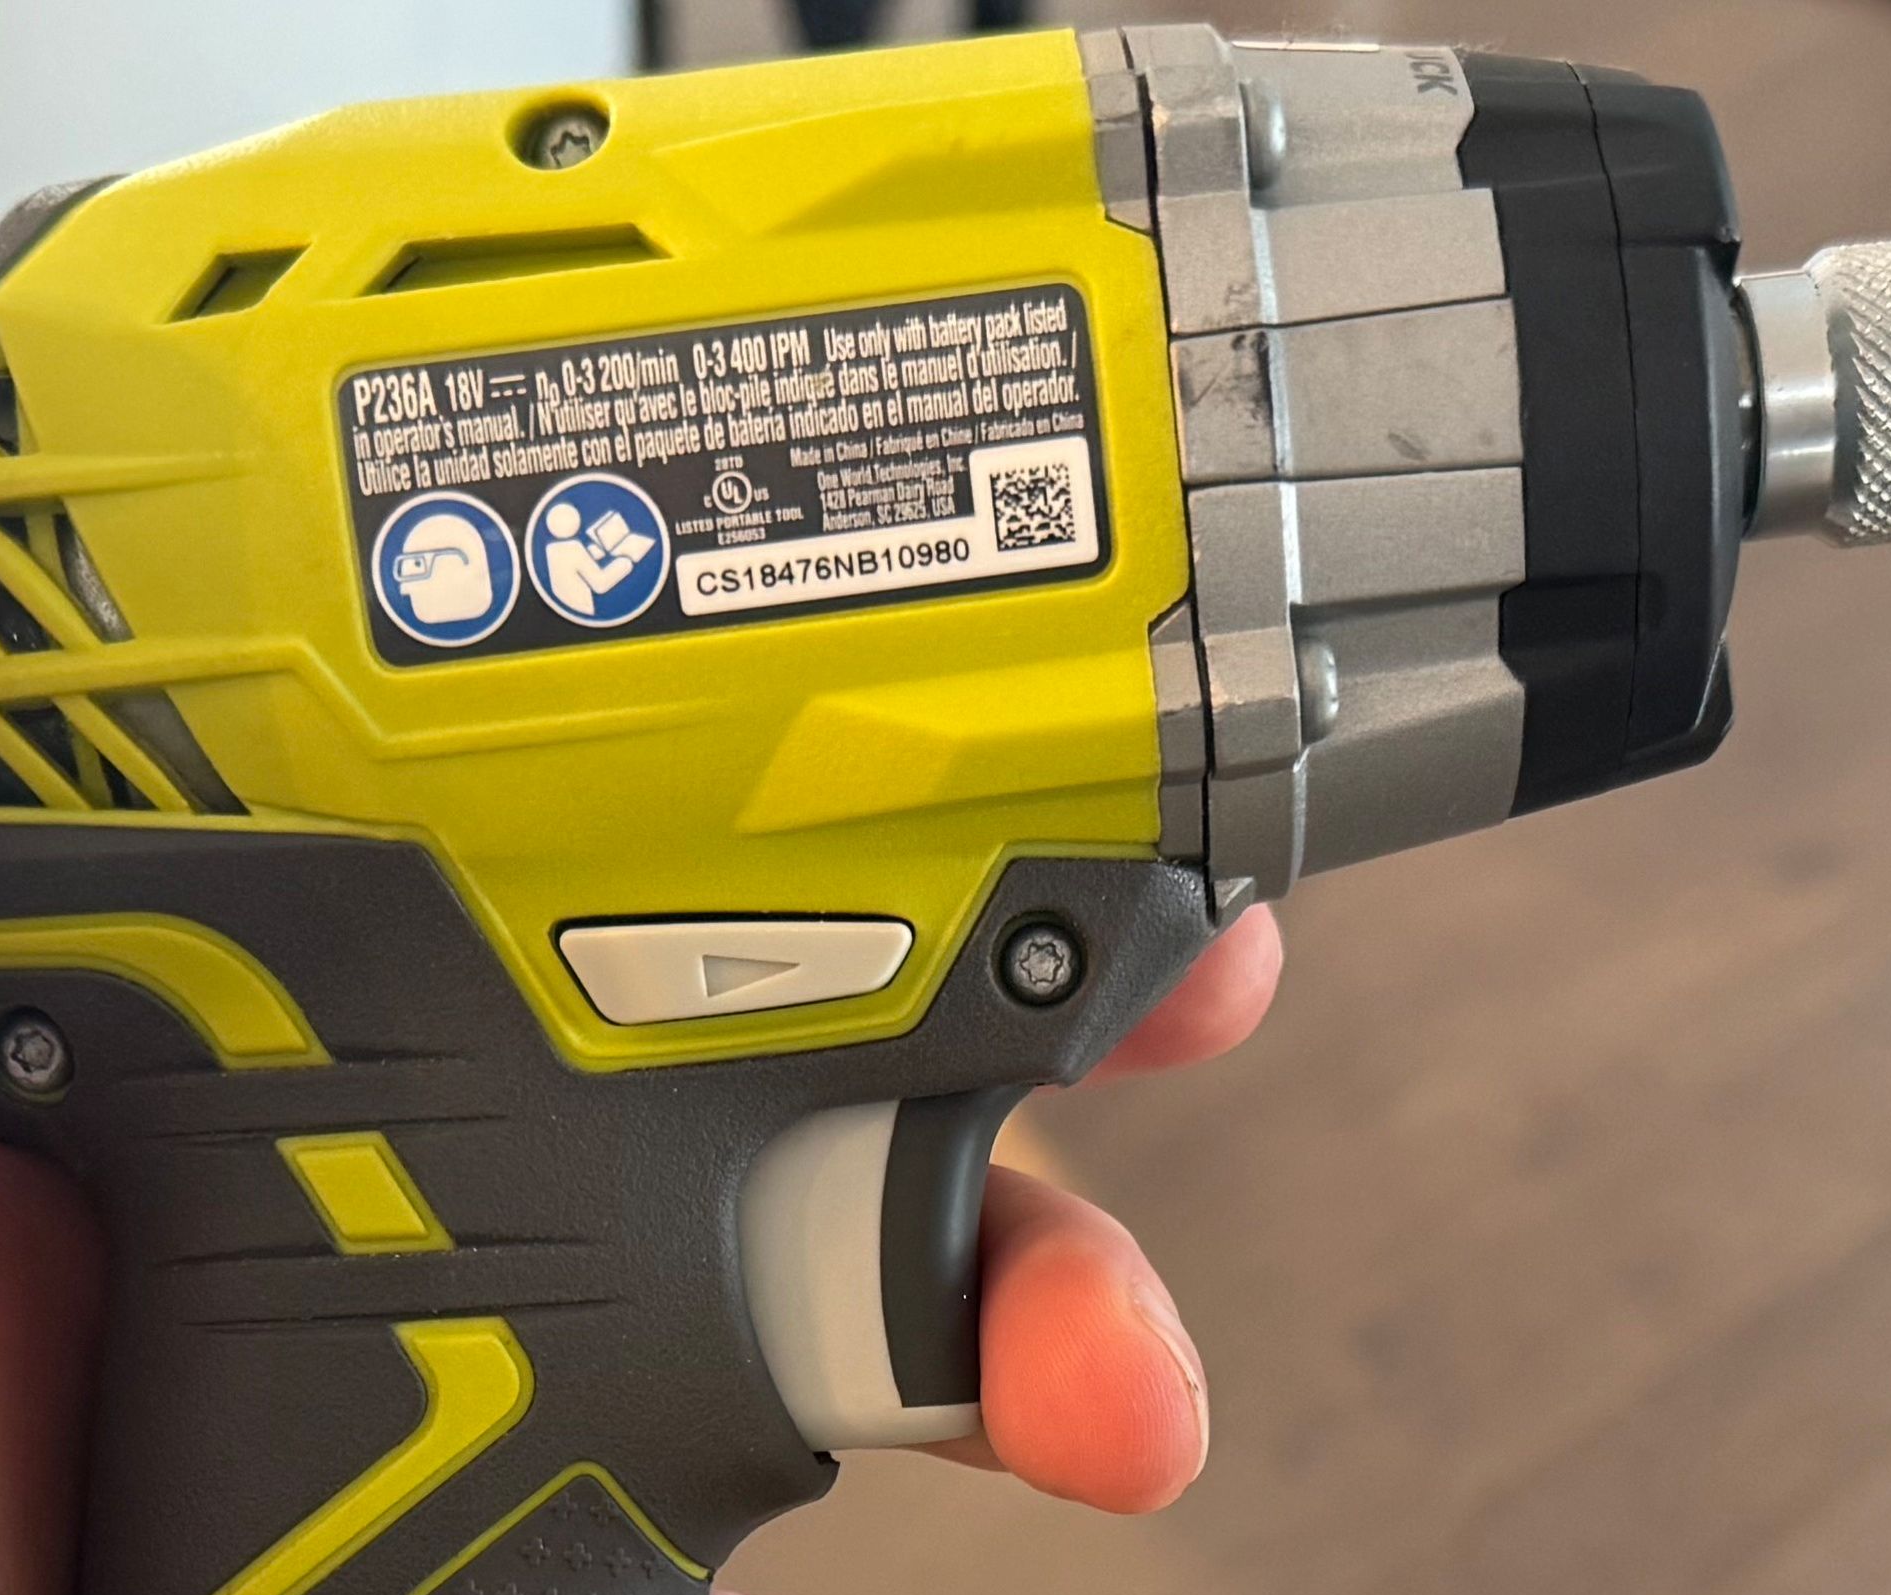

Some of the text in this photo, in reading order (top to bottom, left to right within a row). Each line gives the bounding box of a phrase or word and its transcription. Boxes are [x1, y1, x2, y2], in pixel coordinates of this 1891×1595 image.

[353, 369, 437, 425] P236A
[445, 367, 484, 412] 18V
[599, 348, 680, 393] 200/min
[692, 340, 727, 380] 0-3
[730, 335, 767, 375] 400
[770, 329, 811, 369] IPM
[823, 327, 855, 363] Use
[858, 321, 891, 360] only
[894, 316, 927, 353] with
[928, 312, 982, 352] battery
[985, 303, 1022, 347] pack
[1023, 297, 1068, 336] listed
[353, 425, 370, 460] in
[373, 416, 455, 457] operator's
[457, 404, 525, 447] manual.
[536, 396, 611, 436] N'utiliser
[614, 389, 678, 428] qu'avec
[680, 381, 698, 417] le
[699, 371, 771, 415] bloc-pile
[774, 363, 836, 405] indiqué
[837, 360, 879, 397] dans
[880, 355, 898, 391] le
[901, 346, 964, 389] manuel
[966, 338, 1067, 379] d'utilisation.
[356, 457, 411, 497] Utilice
[413, 454, 432, 489] la
[434, 445, 491, 486] unidad
[493, 435, 579, 479] solamente
[581, 433, 612, 468] con
[614, 426, 632, 463] el
[634, 419, 701, 468] paquete
[704, 414, 725, 452] de
[788, 397, 859, 440] indicado
[862, 399, 884, 431] en
[886, 390, 904, 426] el
[906, 382, 969, 424] manual
[972, 377, 999, 415] del
[1002, 369, 1080, 418] operador.
[790, 444, 822, 468] Made
[823, 441, 835, 464] in
[836, 437, 868, 462] China
[925, 428, 940, 449] en
[980, 415, 1035, 442] Fabricado
[1036, 416, 1051, 435] en
[1052, 411, 1085, 433] China
[817, 470, 839, 492] One
[840, 463, 873, 488] World
[847, 486, 896, 508] Pearman
[896, 480, 926, 506] Dairy
[926, 474, 955, 497] Road
[675, 506, 804, 536] LISTED PORTABLE TOOL
[876, 503, 893, 525] SC
[931, 495, 956, 517] USA
[696, 537, 970, 596] CS18476NB10980
